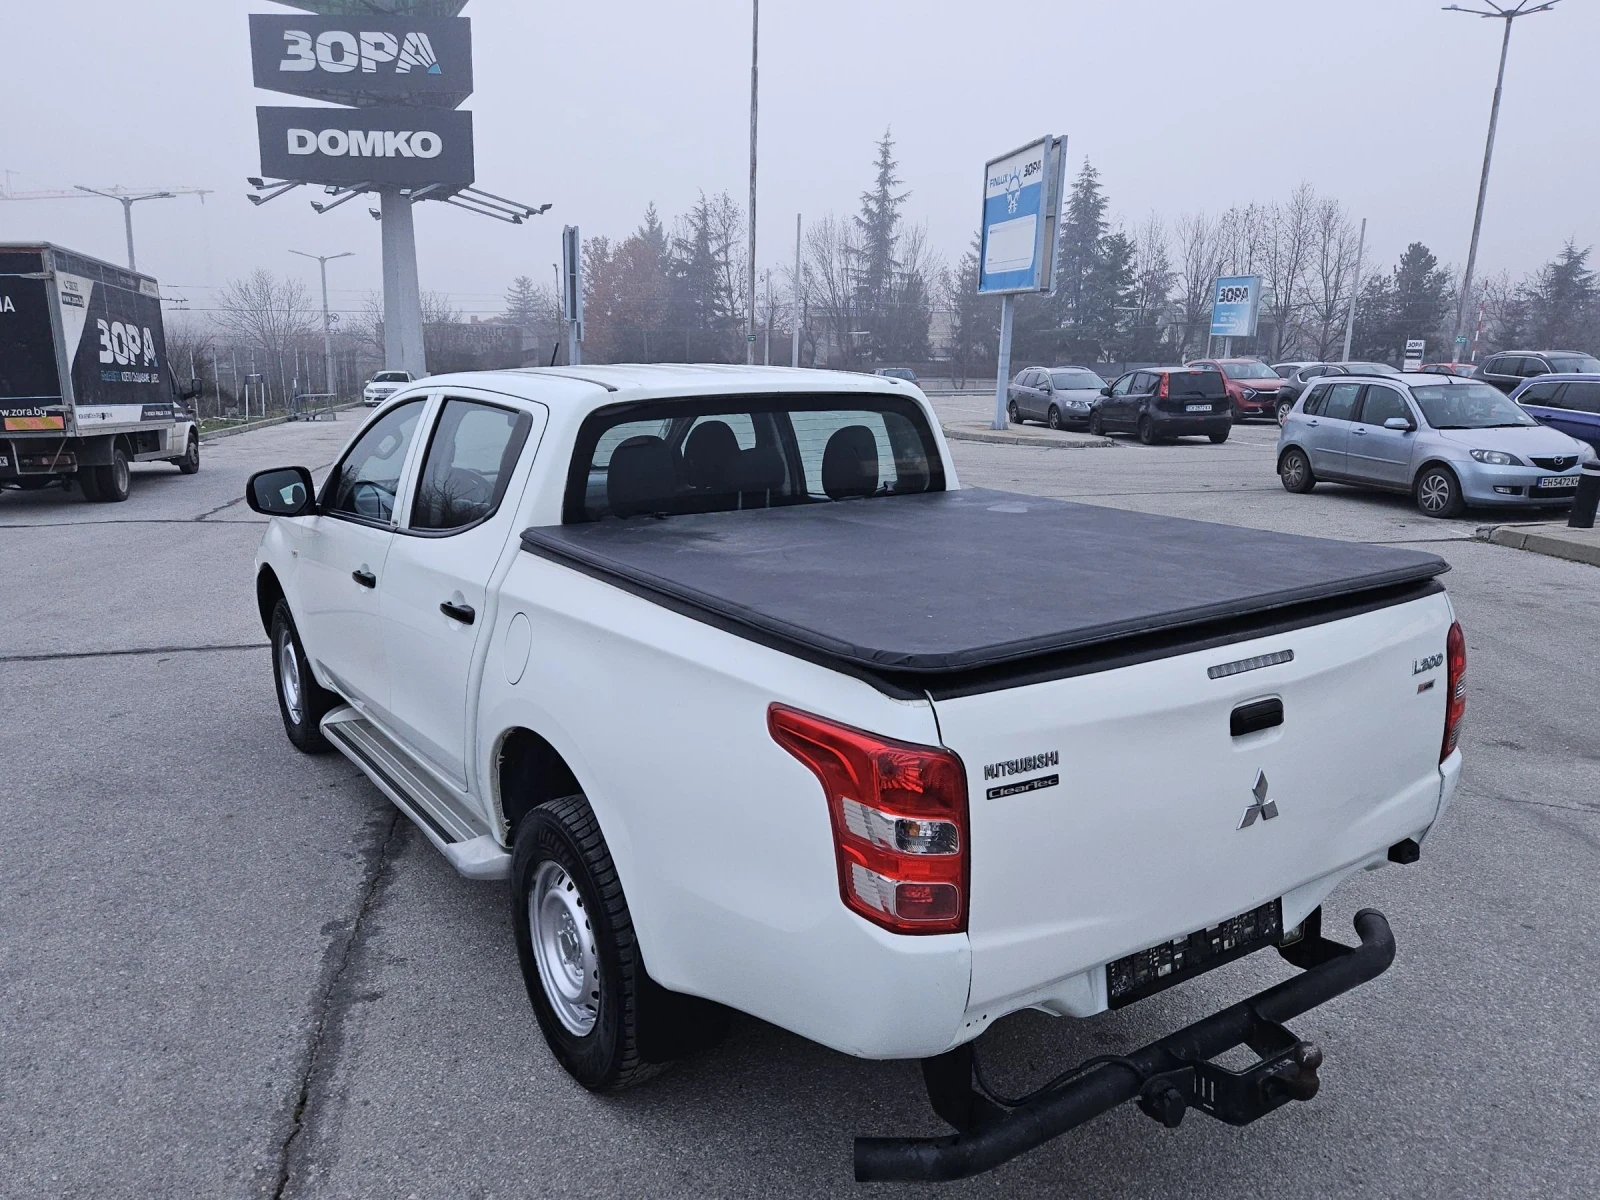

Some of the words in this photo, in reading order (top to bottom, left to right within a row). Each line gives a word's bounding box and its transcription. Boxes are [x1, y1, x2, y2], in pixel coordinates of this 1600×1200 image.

[279, 30, 442, 74] ЗОРА
[287, 128, 443, 159] DOMKO
[989, 174, 1009, 188] FINLUX
[97, 318, 159, 367] ЗОРА
[0, 406, 47, 418] w.zora.bg
[1412, 652, 1444, 676] L200
[983, 750, 1060, 781] MITSUBISHI
[987, 777, 1059, 799] ClearTec
